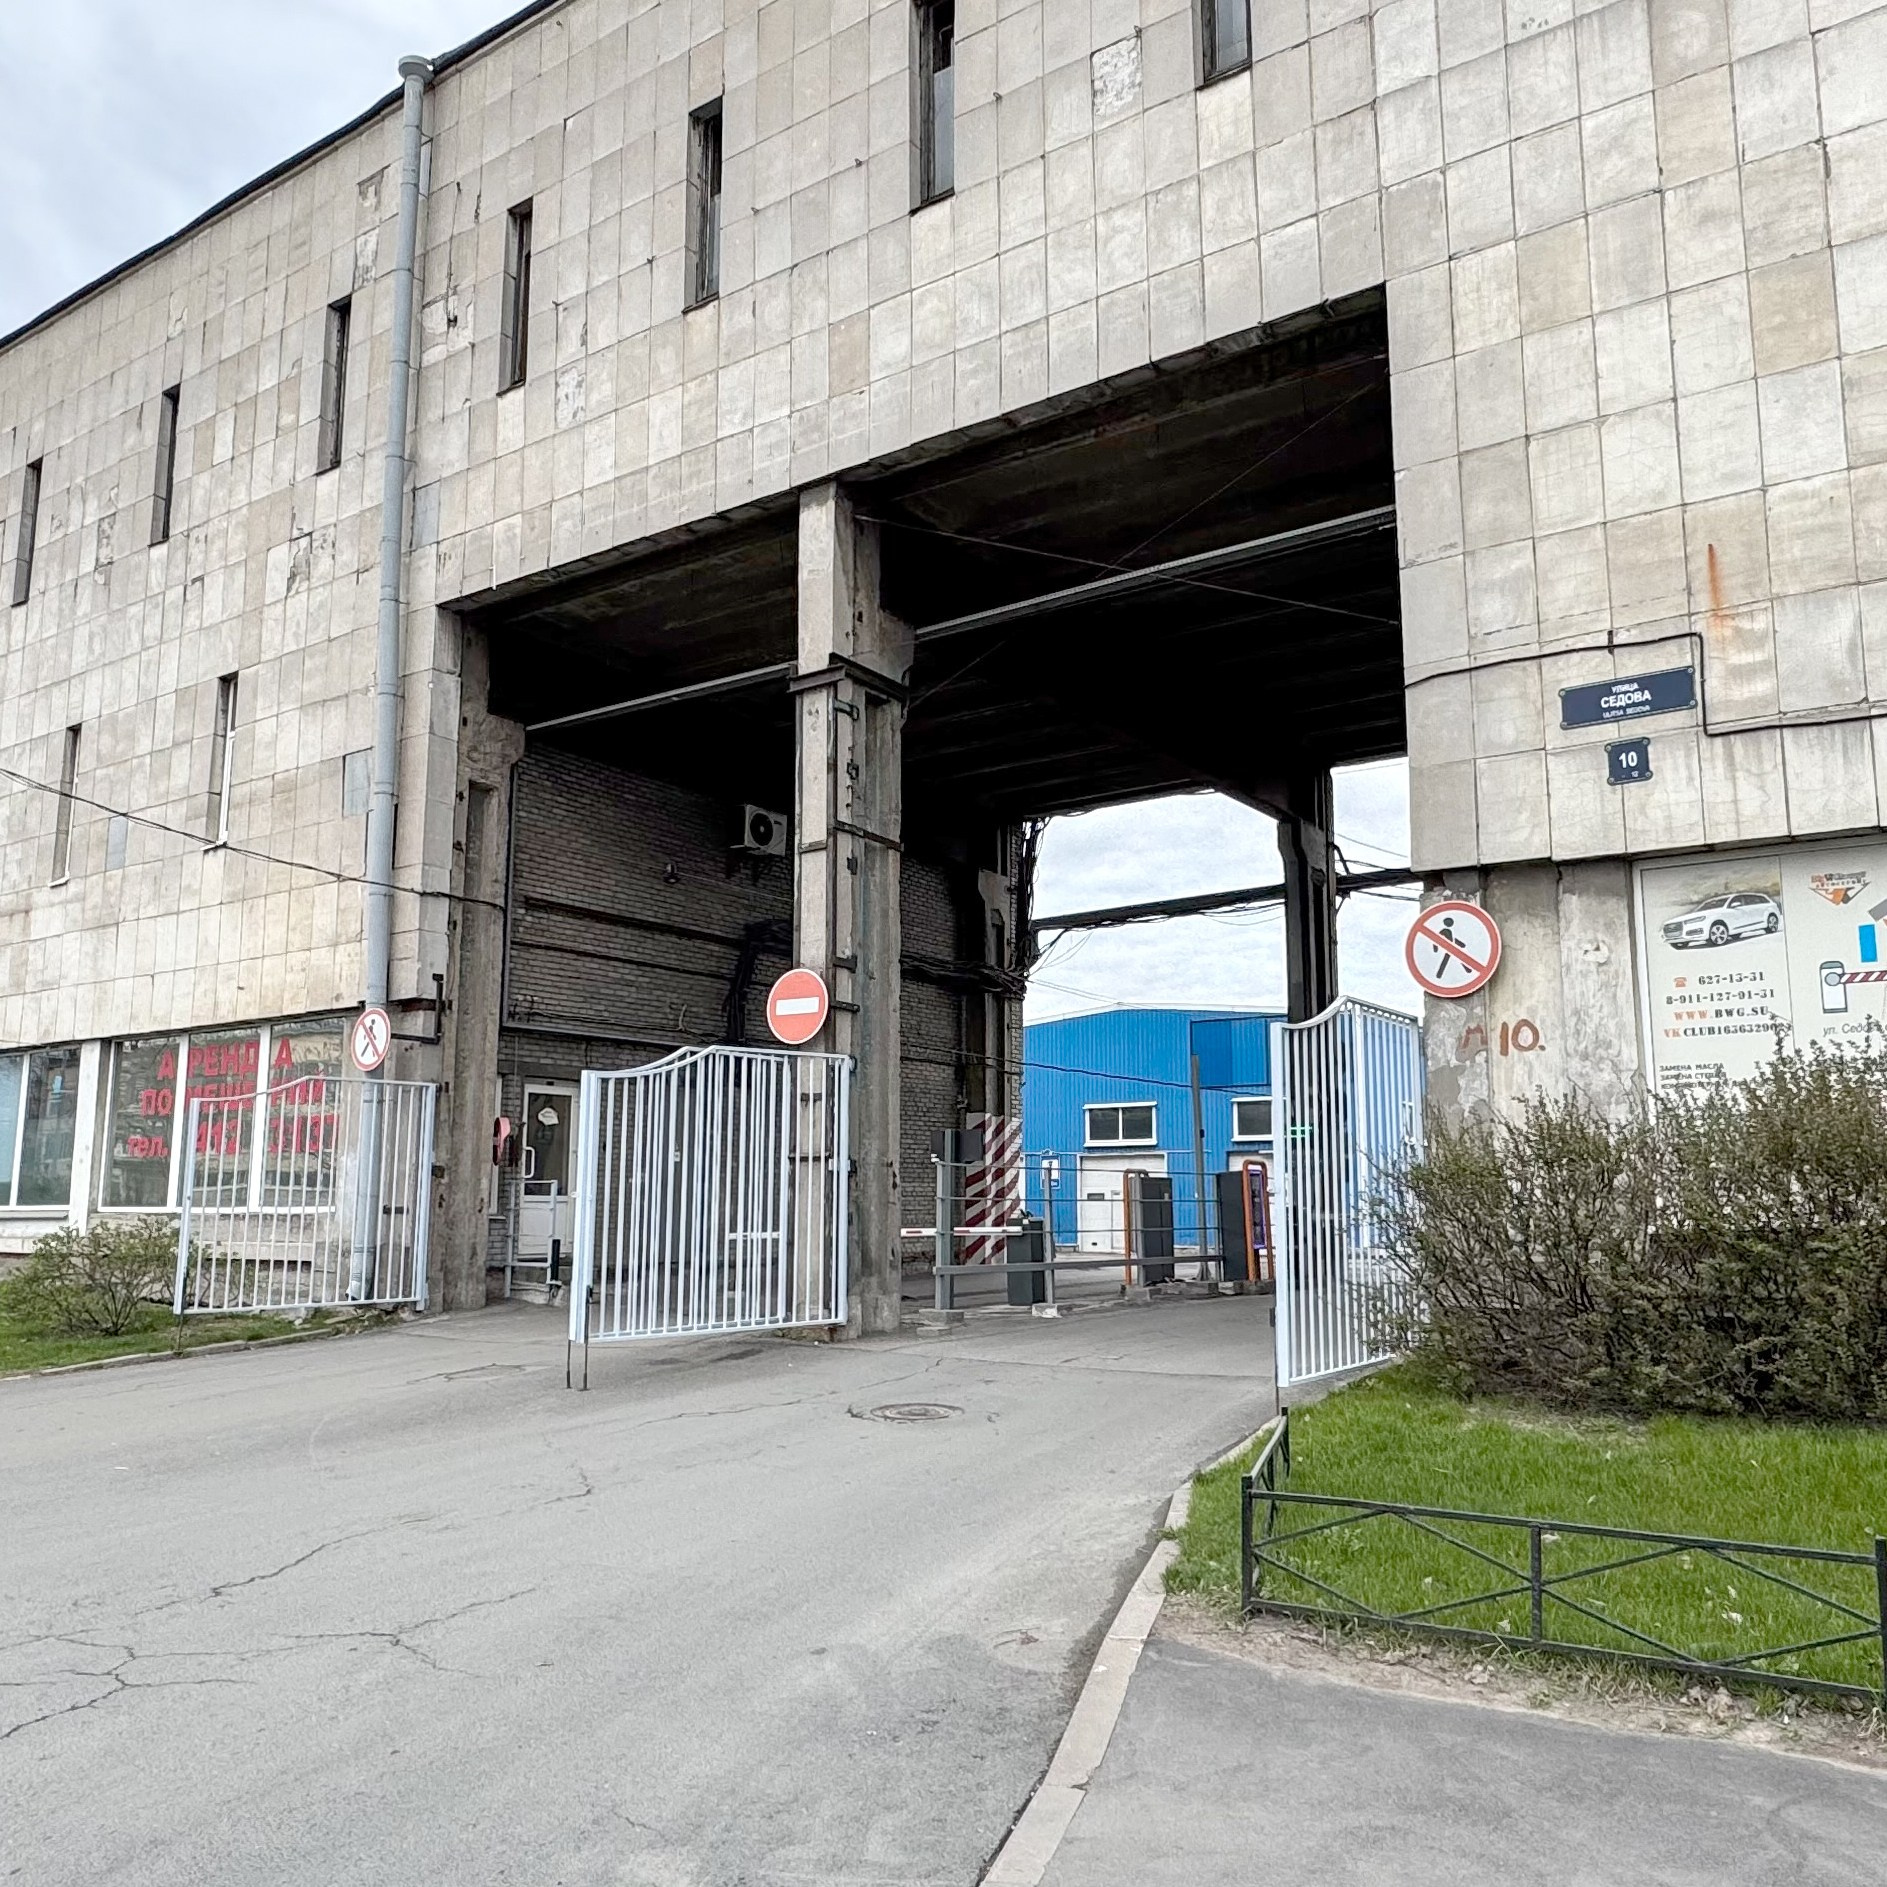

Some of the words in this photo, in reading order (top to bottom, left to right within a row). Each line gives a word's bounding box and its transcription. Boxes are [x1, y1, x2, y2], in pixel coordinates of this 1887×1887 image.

[1611, 682, 1639, 694] УЛИЦА
[1600, 689, 1652, 708] СЕДОВА
[1618, 751, 1638, 769] 10
[1698, 971, 1766, 986] 627-13-31
[1665, 989, 1775, 1005] 8-911-127-91-31
[1673, 1005, 1769, 1021] WWW.BWG.SU
[1659, 1064, 1692, 1072] ЗАМЕНА
[127, 1136, 168, 1159] тел.
